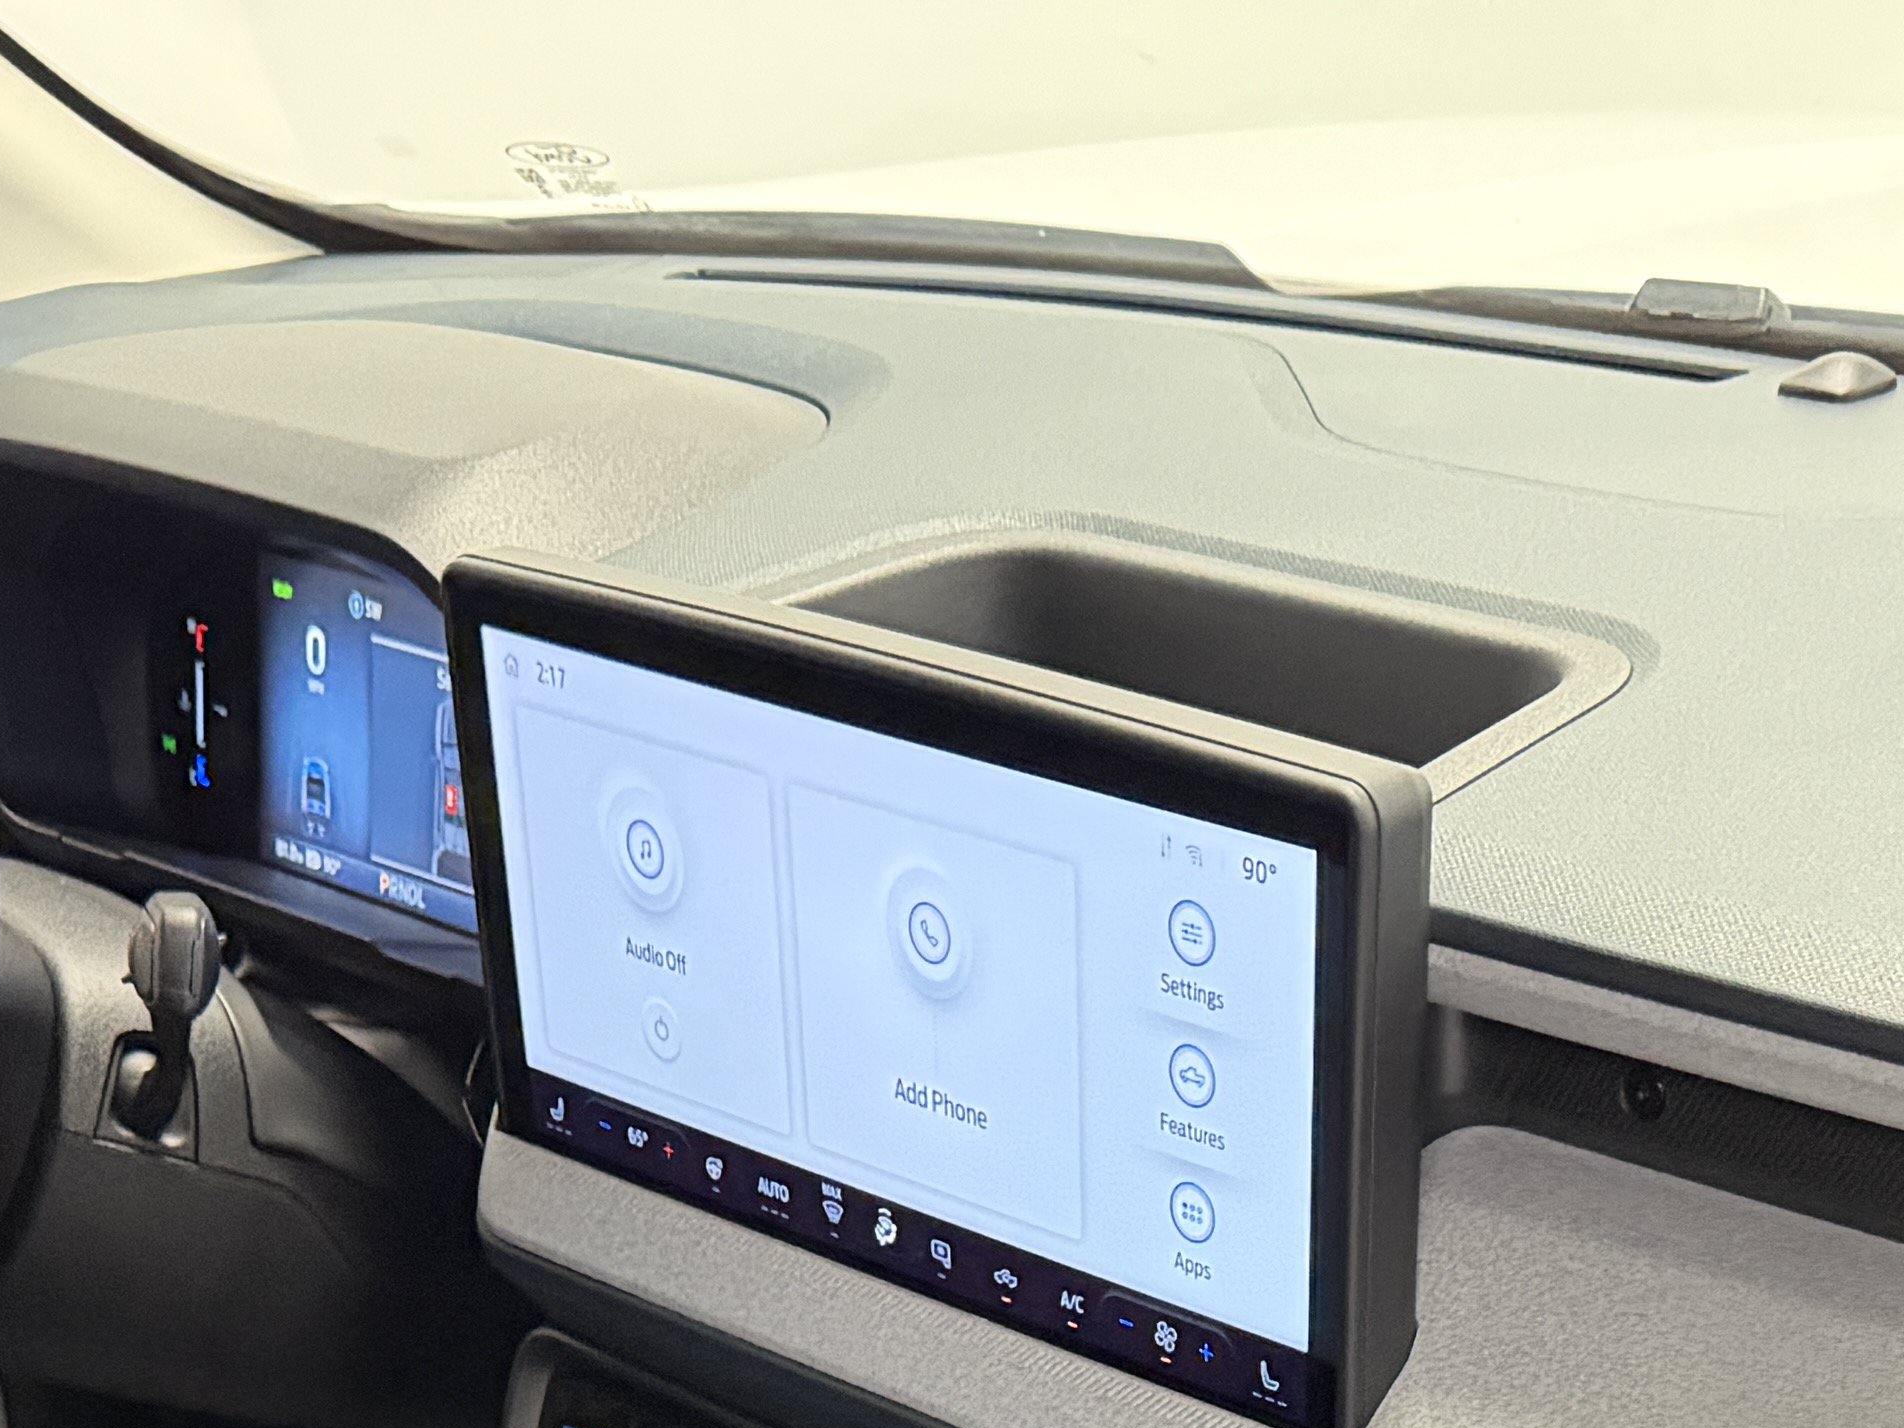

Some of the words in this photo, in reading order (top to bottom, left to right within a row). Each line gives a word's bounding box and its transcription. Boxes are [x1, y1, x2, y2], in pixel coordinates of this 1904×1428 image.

[306, 625, 327, 676] 0
[536, 661, 567, 690] 2:17
[1242, 856, 1277, 884] 90°
[626, 936, 664, 968] Audio
[666, 950, 687, 976] Off
[1160, 972, 1225, 1011] Settings
[894, 1077, 928, 1109] Add
[932, 1089, 988, 1130] Phone
[627, 1126, 649, 1148] 65°
[1159, 1111, 1226, 1151] Features
[757, 1176, 790, 1203] AUTO
[821, 1181, 844, 1201] MAX
[1173, 1251, 1213, 1281] Apps
[1060, 1290, 1085, 1314] A/C
